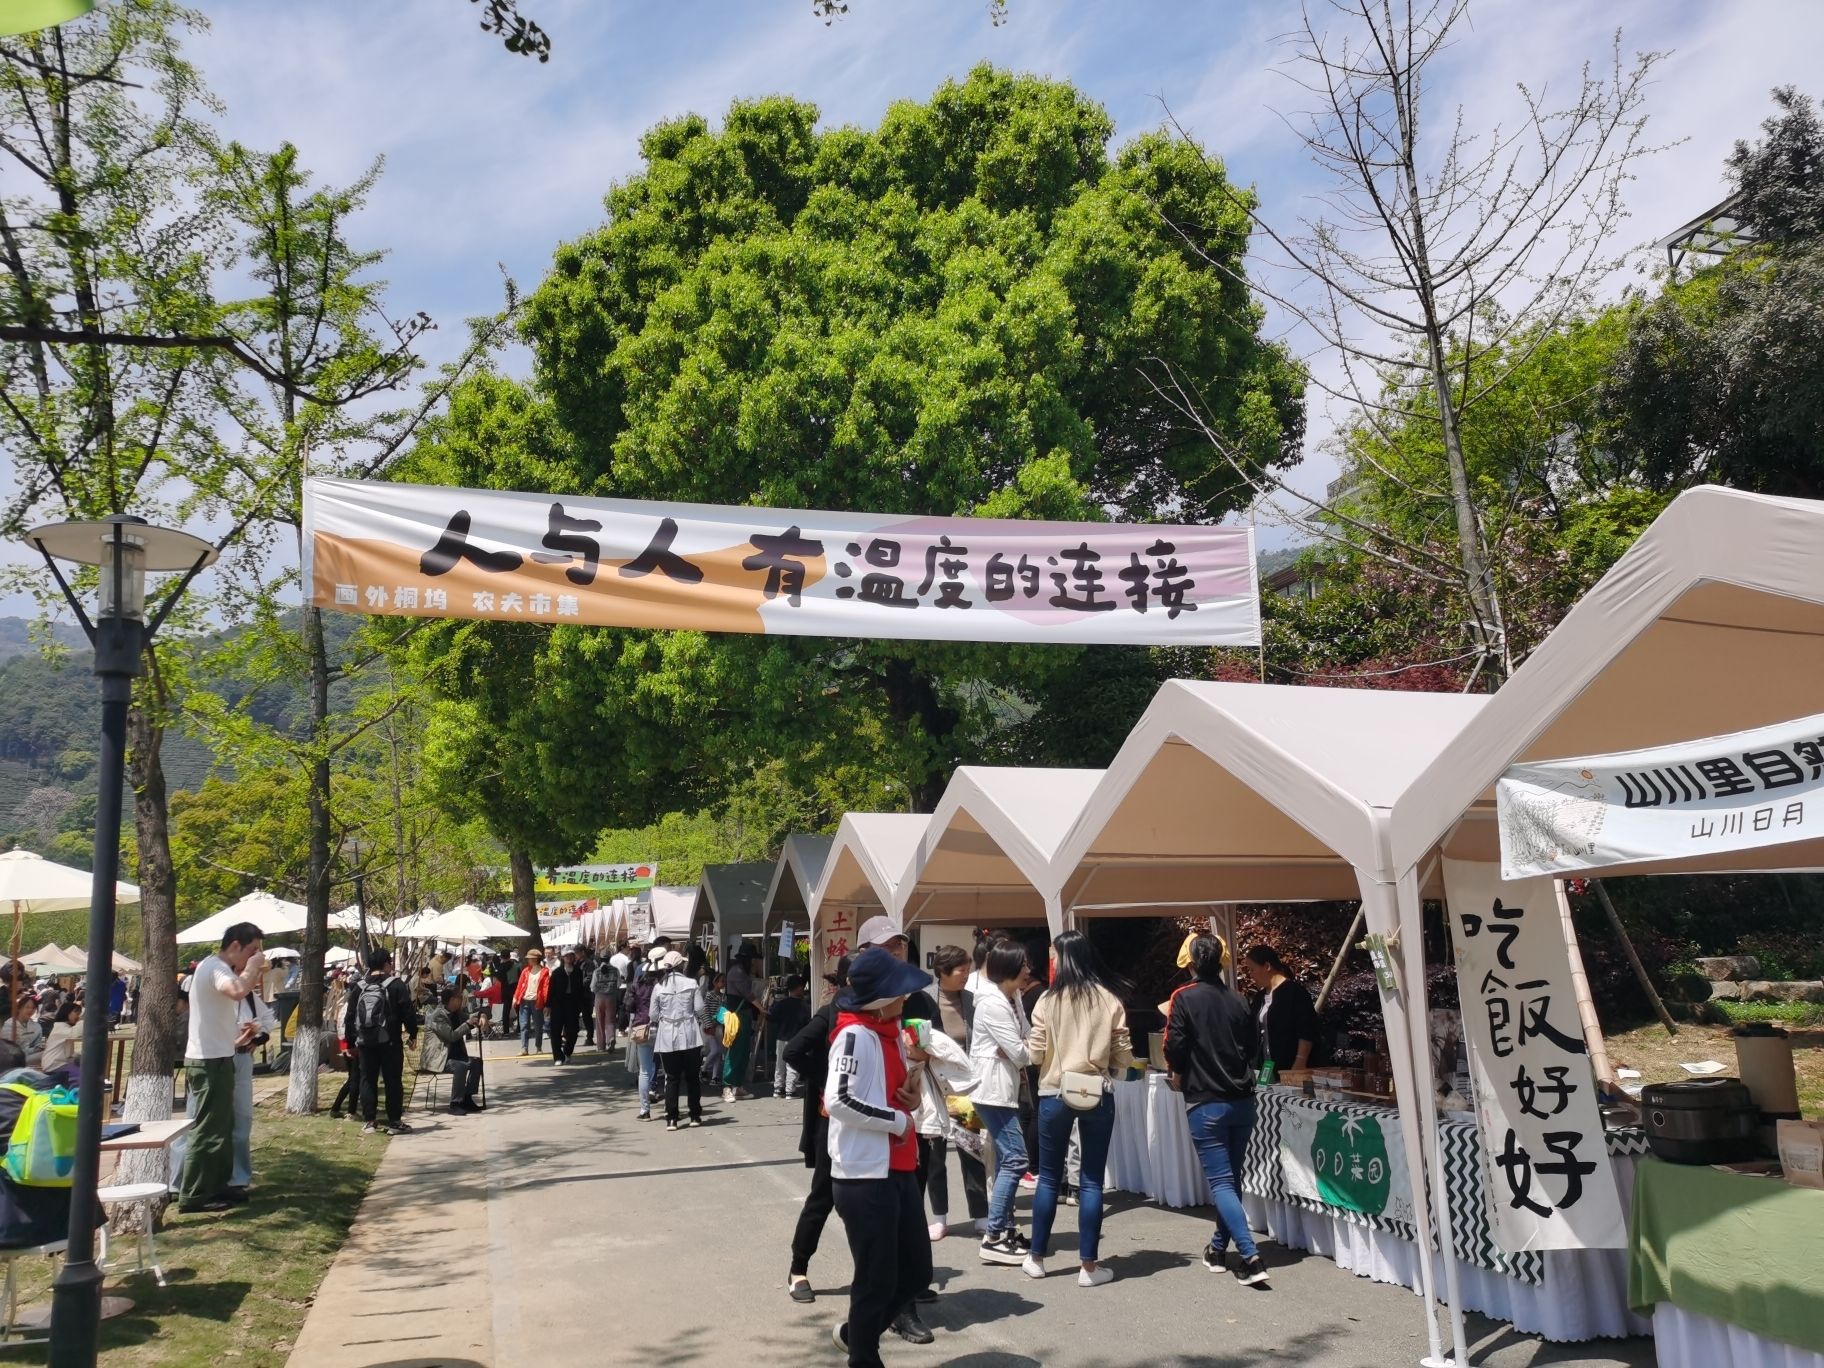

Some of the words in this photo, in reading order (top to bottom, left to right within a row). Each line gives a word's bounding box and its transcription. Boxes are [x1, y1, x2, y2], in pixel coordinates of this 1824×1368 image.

[420, 502, 704, 585] 人与人
[742, 525, 1198, 620] 有温度的连接
[334, 583, 447, 610] 画外桐坞
[472, 590, 580, 617] 农夫市集
[1691, 802, 1803, 838] 山川日月
[535, 902, 589, 917] 温度的连接
[835, 1057, 858, 1076] 1911
